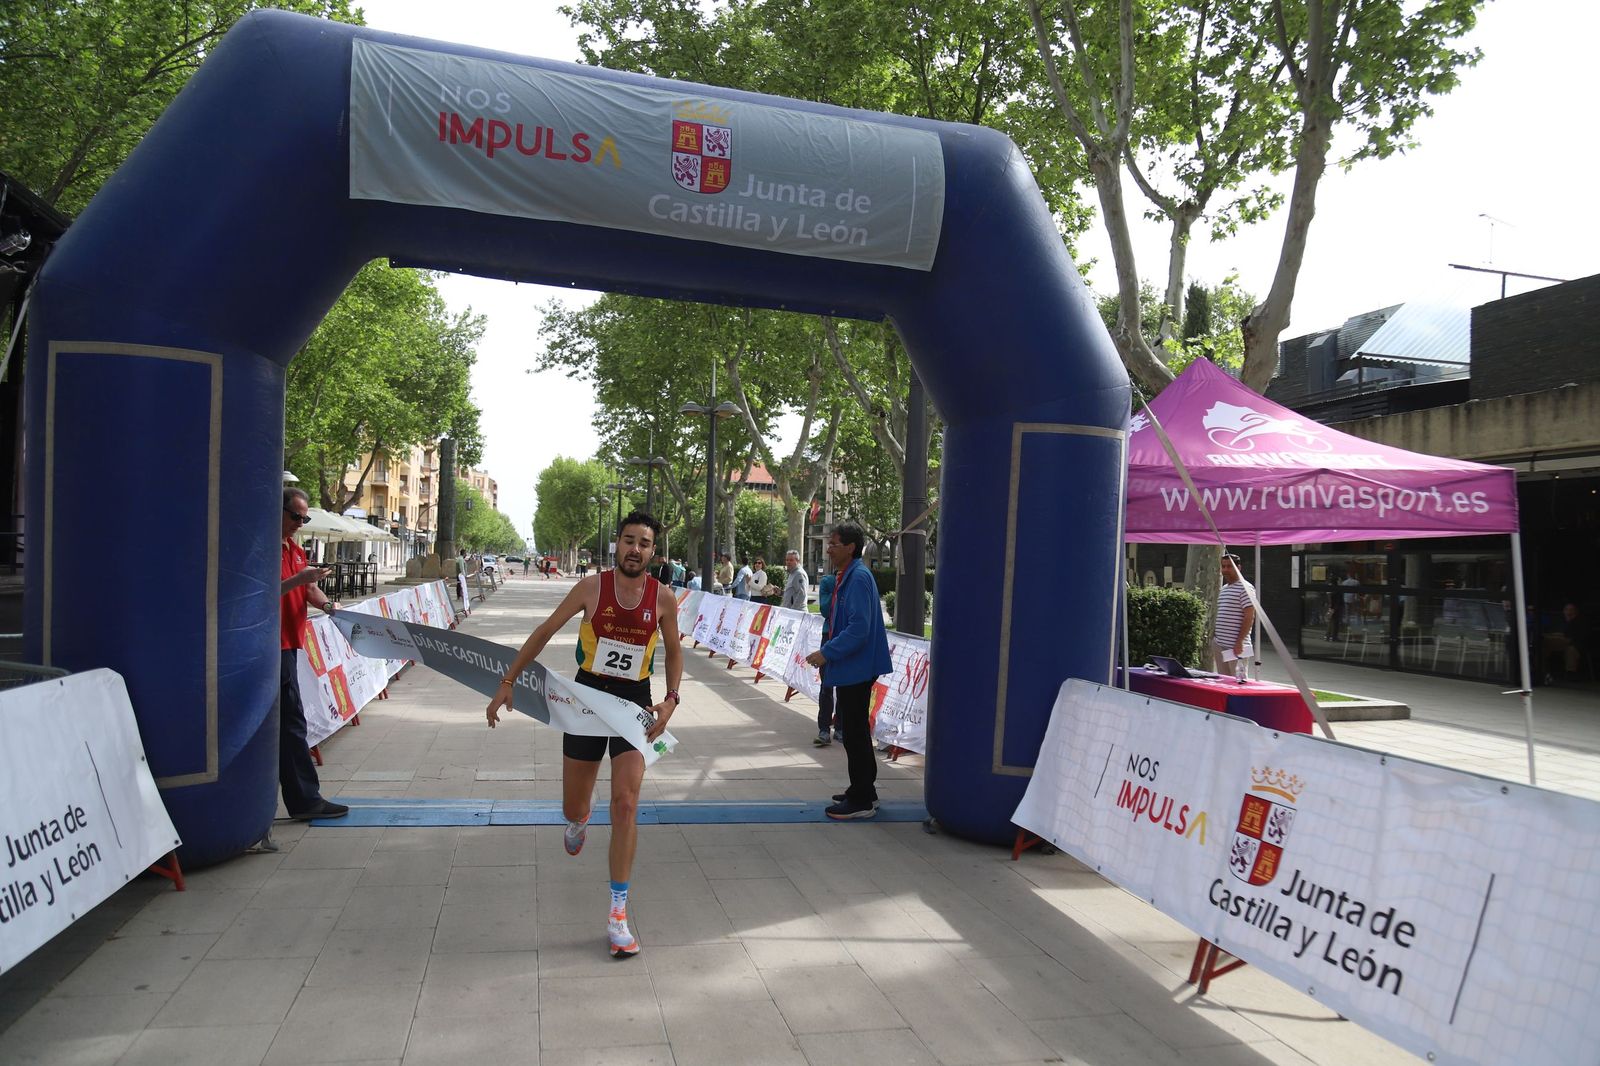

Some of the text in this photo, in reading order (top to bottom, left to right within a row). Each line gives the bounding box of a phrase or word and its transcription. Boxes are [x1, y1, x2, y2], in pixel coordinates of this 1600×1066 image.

[440, 85, 511, 114] NOS
[438, 111, 622, 169] IMPULSA
[648, 193, 868, 247] Castilla y León
[738, 174, 872, 214] Junta de
[1160, 484, 1490, 518] www.runvasport.es
[412, 633, 435, 652] DÍA
[435, 640, 452, 656] DE
[452, 645, 504, 676] CASTILLA
[605, 651, 633, 671] 25
[1126, 753, 1160, 782] NOS
[5, 804, 88, 868] Junta de
[1116, 779, 1207, 846] IMPULSA
[40, 870, 55, 906] y
[53, 842, 102, 886] León
[1281, 869, 1416, 949] Junta de
[1209, 878, 1405, 995] Castilla y León
